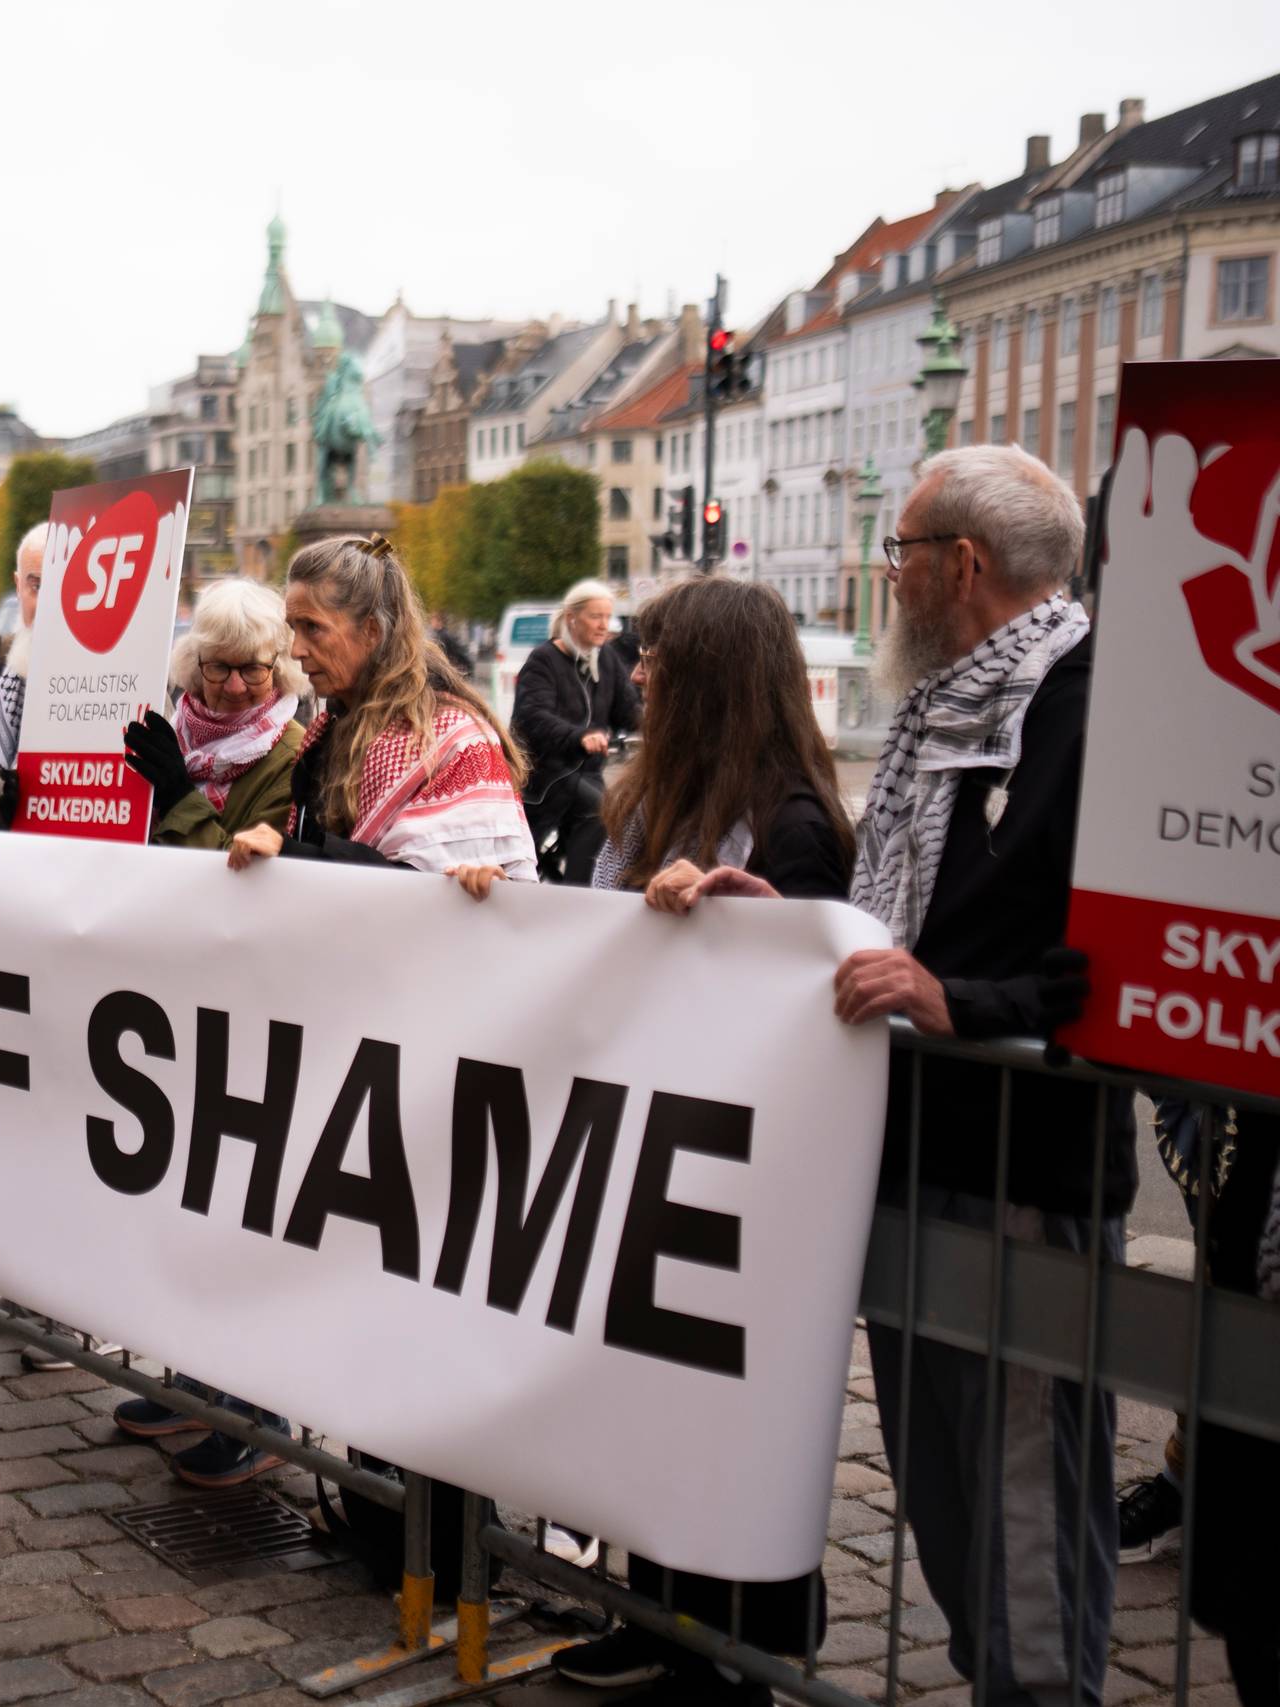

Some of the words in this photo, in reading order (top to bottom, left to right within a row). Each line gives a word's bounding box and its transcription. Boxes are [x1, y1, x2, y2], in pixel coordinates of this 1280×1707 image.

[76, 534, 144, 611] SF
[48, 674, 139, 694] SOCIALISTISK
[48, 703, 131, 721] FOLKEPARTI
[40, 760, 114, 787] SKYLDIG
[117, 762, 125, 787] I
[1249, 763, 1280, 797] S
[26, 796, 131, 824] FOLKEDRAB
[86, 990, 754, 1378] SHAME
